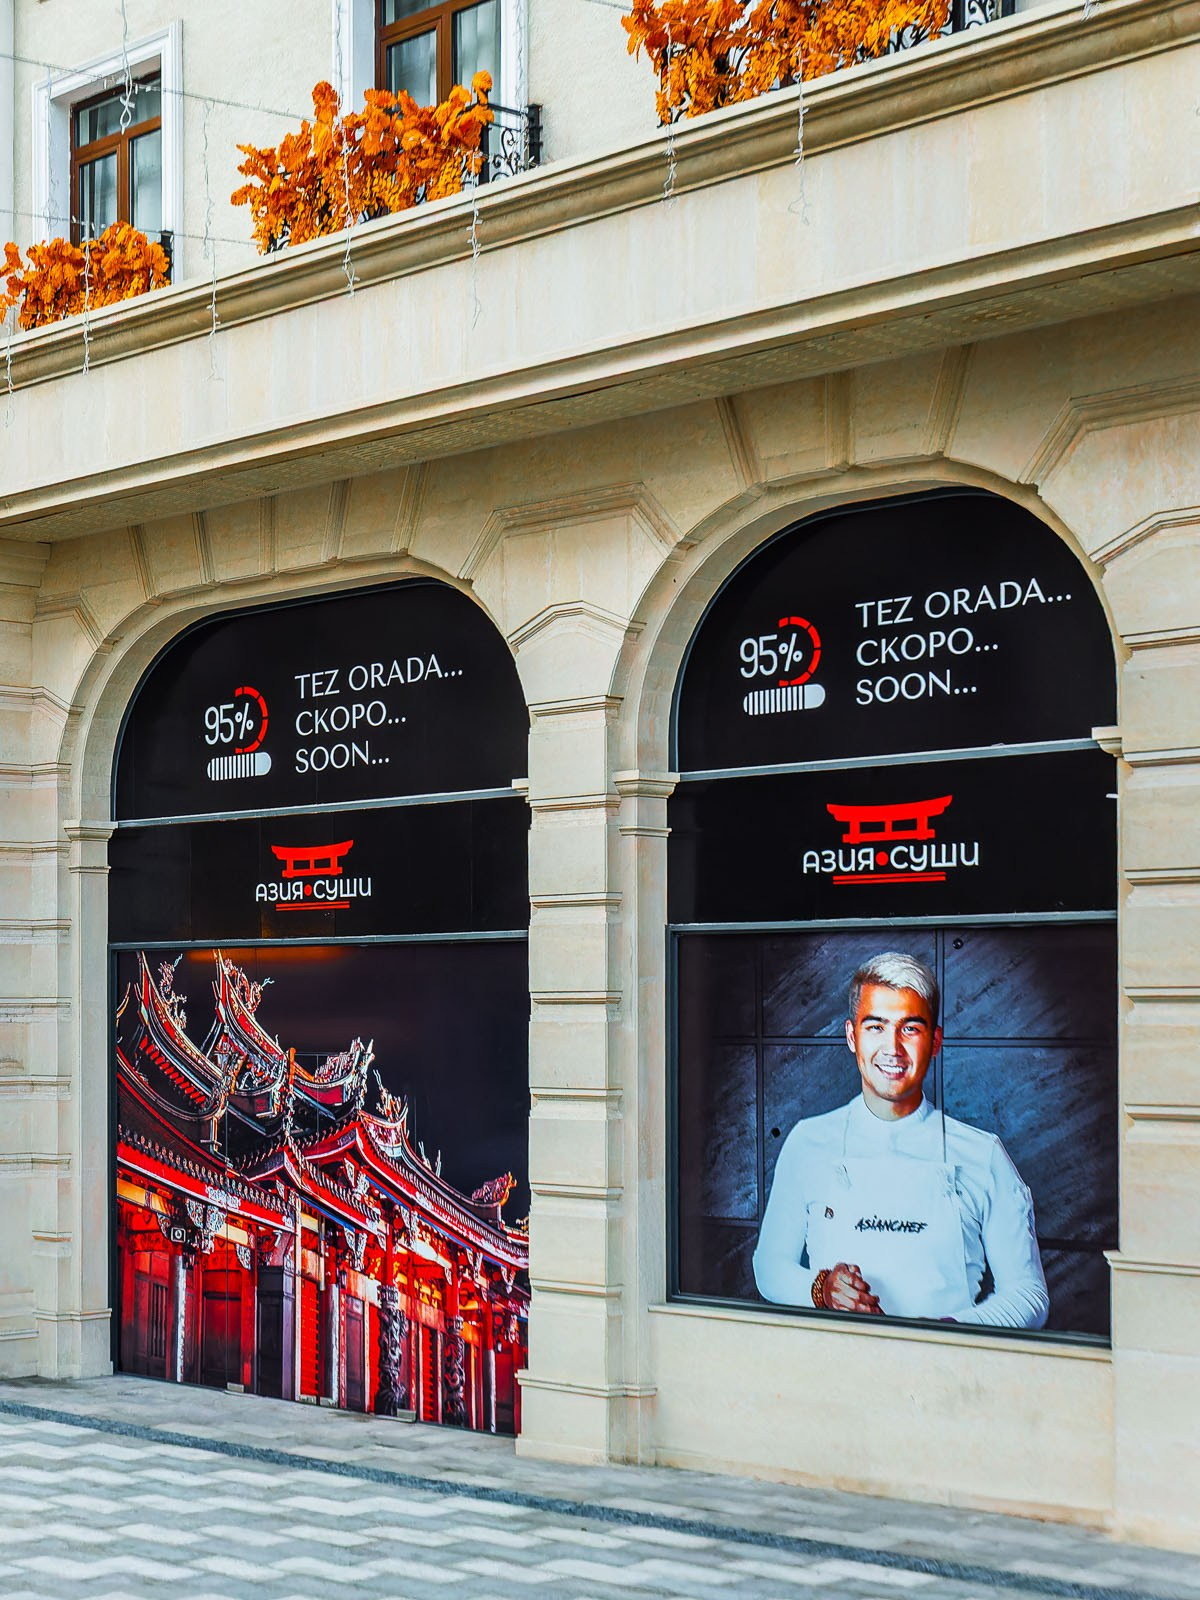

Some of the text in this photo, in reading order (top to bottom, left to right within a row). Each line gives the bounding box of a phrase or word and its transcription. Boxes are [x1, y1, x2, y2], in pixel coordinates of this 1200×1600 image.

[855, 578, 1072, 628] TEZ ORADA...
[295, 654, 463, 699] TEZ ORADA...
[739, 633, 803, 679] 95%
[857, 670, 977, 706] SOON...
[204, 703, 254, 745] 95%
[295, 741, 390, 774] SOON...
